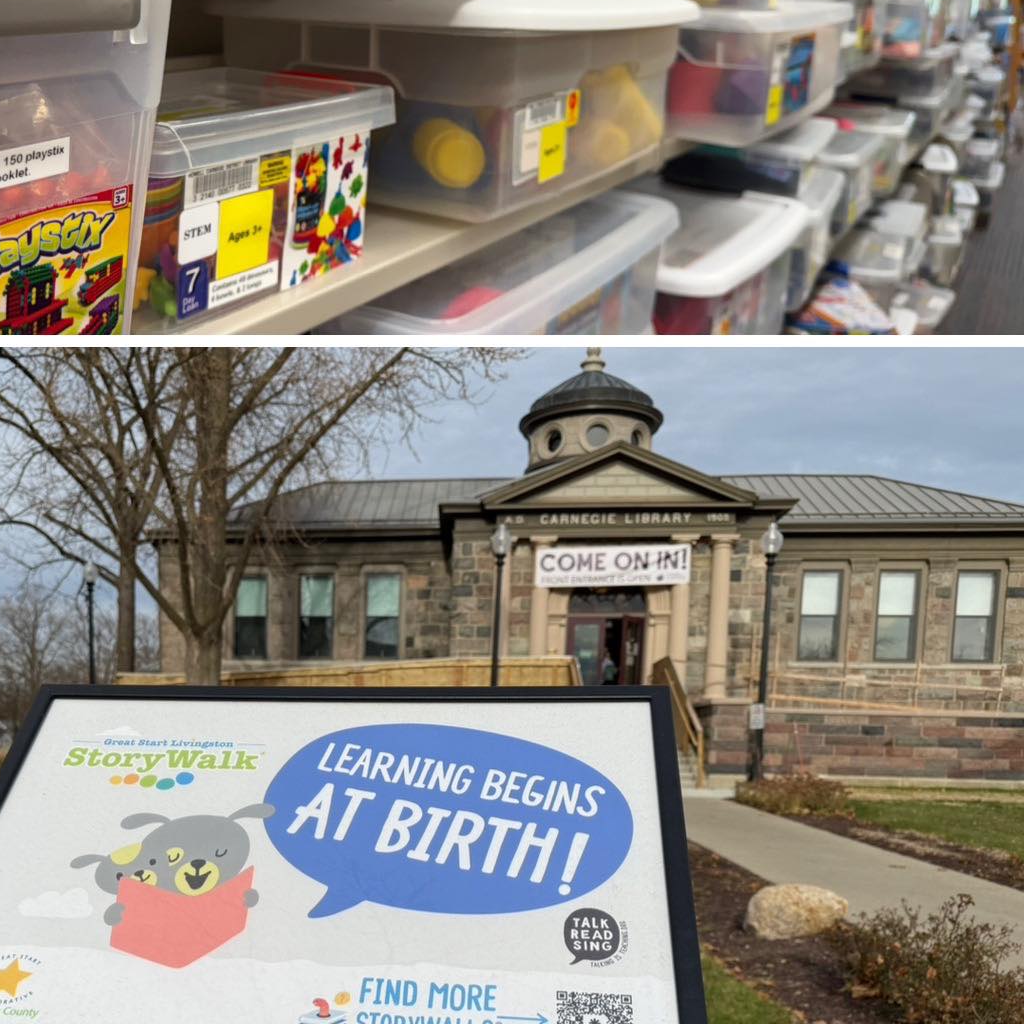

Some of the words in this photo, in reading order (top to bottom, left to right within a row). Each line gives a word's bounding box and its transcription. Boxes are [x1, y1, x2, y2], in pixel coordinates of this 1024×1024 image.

[4, 154, 23, 166] 150
[26, 144, 65, 164] playstix
[115, 195, 125, 204] 3+
[183, 223, 212, 241] STEM
[228, 229, 250, 244] Ages
[252, 224, 263, 236] 3+
[185, 266, 200, 294] 7
[539, 513, 617, 525] CARNEGIE
[625, 512, 692, 523] LIBRARY
[540, 553, 606, 572] COME
[614, 552, 649, 570] ON
[657, 548, 687, 570] IN!
[103, 738, 135, 747] Great
[138, 739, 168, 747] Start
[171, 740, 234, 749] Livingston
[63, 747, 259, 773] StoryWalk
[317, 742, 475, 795] LEARNING
[480, 768, 606, 817] BEGINS
[286, 782, 377, 841] AT
[374, 799, 590, 896] BIRTH!
[572, 916, 609, 929] TALK
[570, 928, 614, 941] READ
[573, 940, 613, 952] SING
[20, 954, 42, 966] START
[359, 977, 418, 1007] FIND
[427, 981, 498, 1012] MORE
[3, 1006, 40, 1019] County
